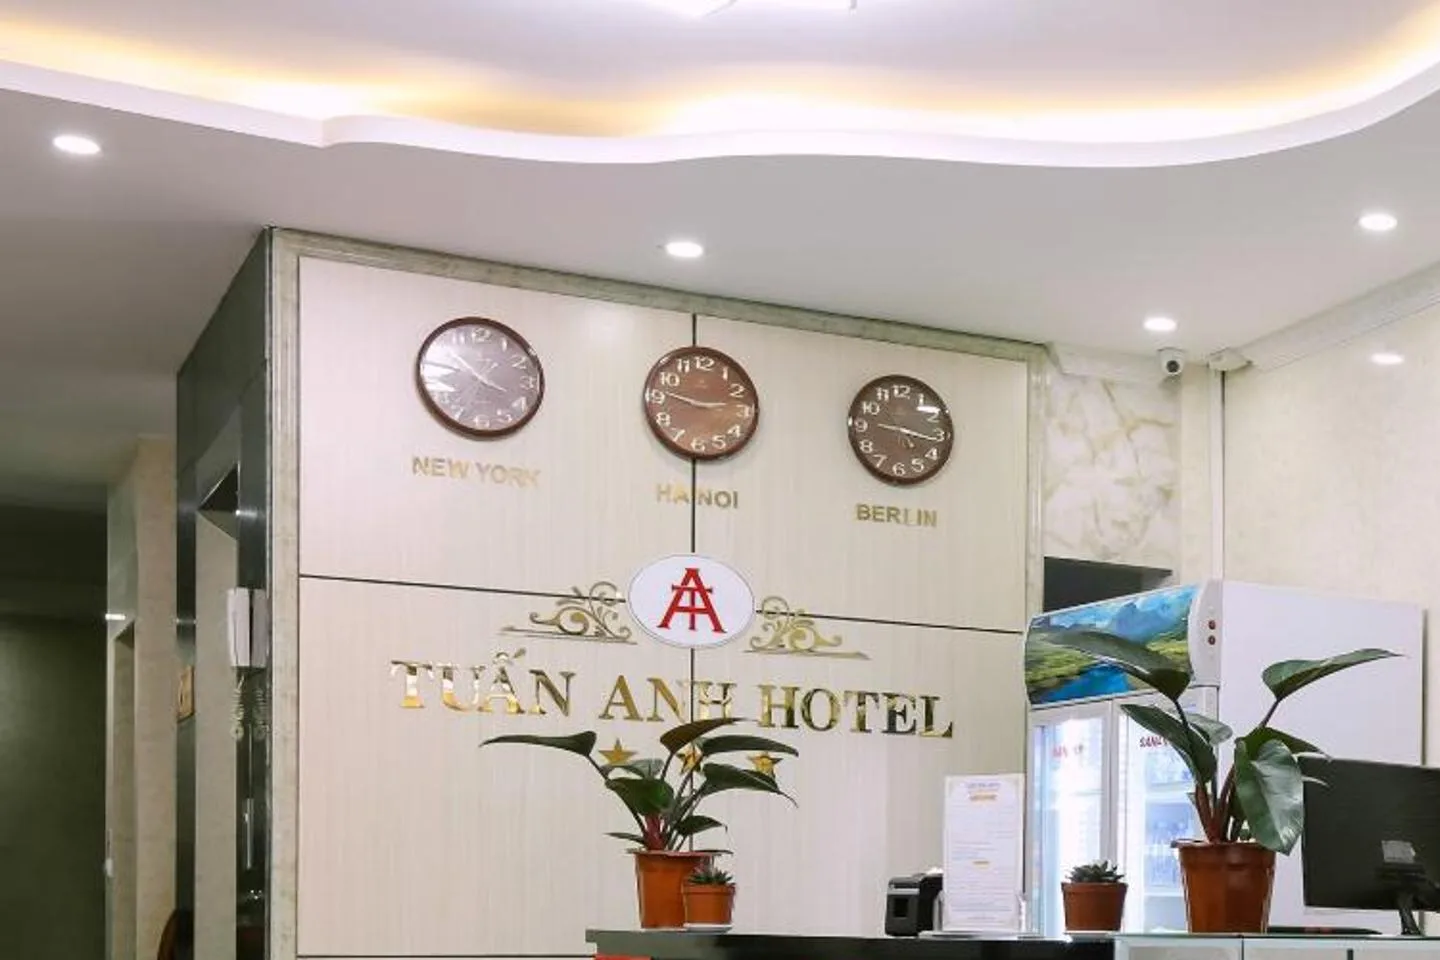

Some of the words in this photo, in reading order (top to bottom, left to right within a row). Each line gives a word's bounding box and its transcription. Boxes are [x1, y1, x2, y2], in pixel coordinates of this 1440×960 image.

[677, 358, 690, 373] 11
[694, 357, 715, 371] 12
[660, 372, 680, 387] 10
[729, 383, 745, 398] 2
[876, 387, 890, 401] 11
[892, 385, 911, 400] 12
[736, 404, 750, 419] 3
[862, 401, 880, 416] 10
[656, 412, 671, 427] 8
[854, 418, 868, 433] 9
[670, 427, 686, 442] 7
[727, 424, 741, 438] 4
[690, 438, 706, 452] 6
[711, 435, 727, 450] 5
[859, 439, 874, 454] 8
[872, 454, 888, 468] 7
[924, 447, 938, 461] 4
[412, 456, 468, 480] NEW
[477, 464, 541, 488] YORK
[892, 462, 906, 477] 6
[911, 458, 925, 473] 5
[656, 482, 739, 509] HANOI
[856, 503, 937, 528] BERLIN
[391, 648, 576, 716] TUẤN
[599, 674, 735, 722] ANH
[757, 684, 955, 738] HOTEL
